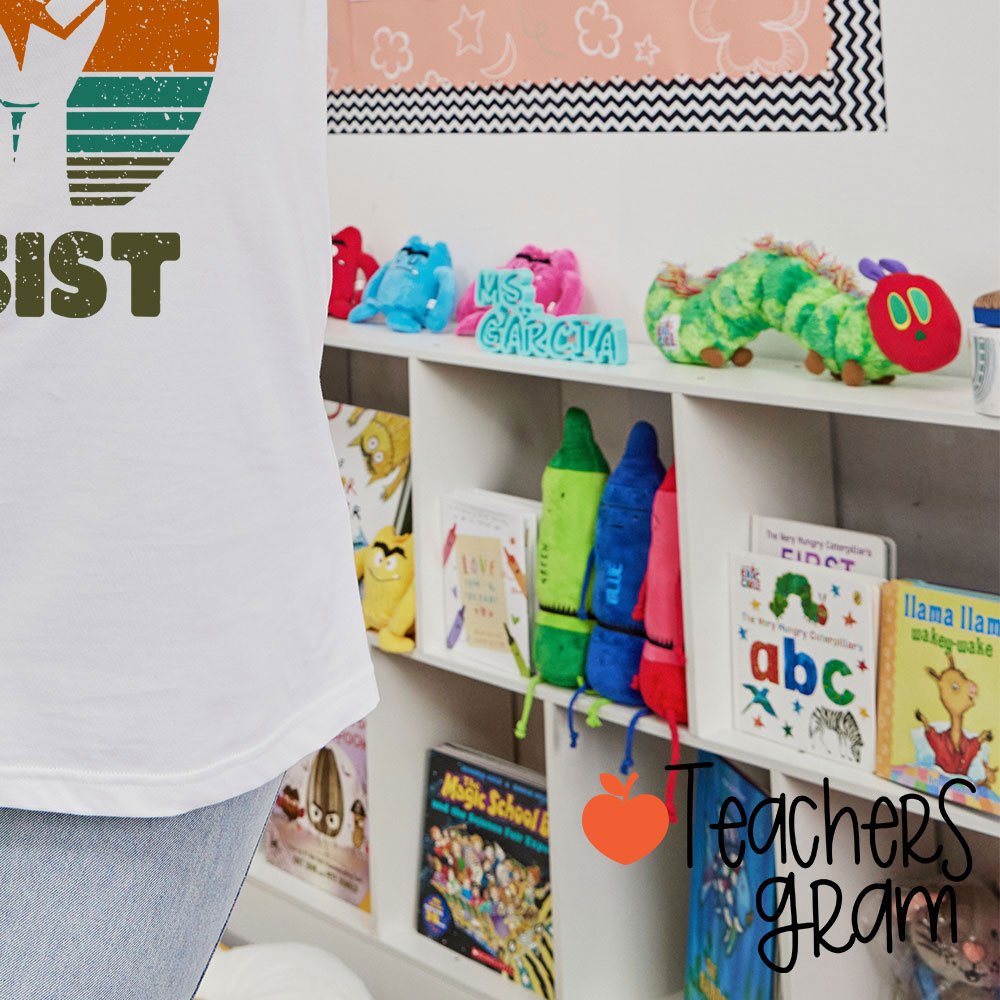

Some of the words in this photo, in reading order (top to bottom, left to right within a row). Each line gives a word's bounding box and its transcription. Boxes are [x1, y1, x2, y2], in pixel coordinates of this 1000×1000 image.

[478, 312, 617, 366] GARCIA
[461, 553, 496, 577] LOVE
[904, 593, 954, 628] llama
[911, 626, 994, 658] wakey-wake
[750, 636, 856, 706] abc
[441, 771, 487, 811] Magic
[486, 788, 541, 833] School
